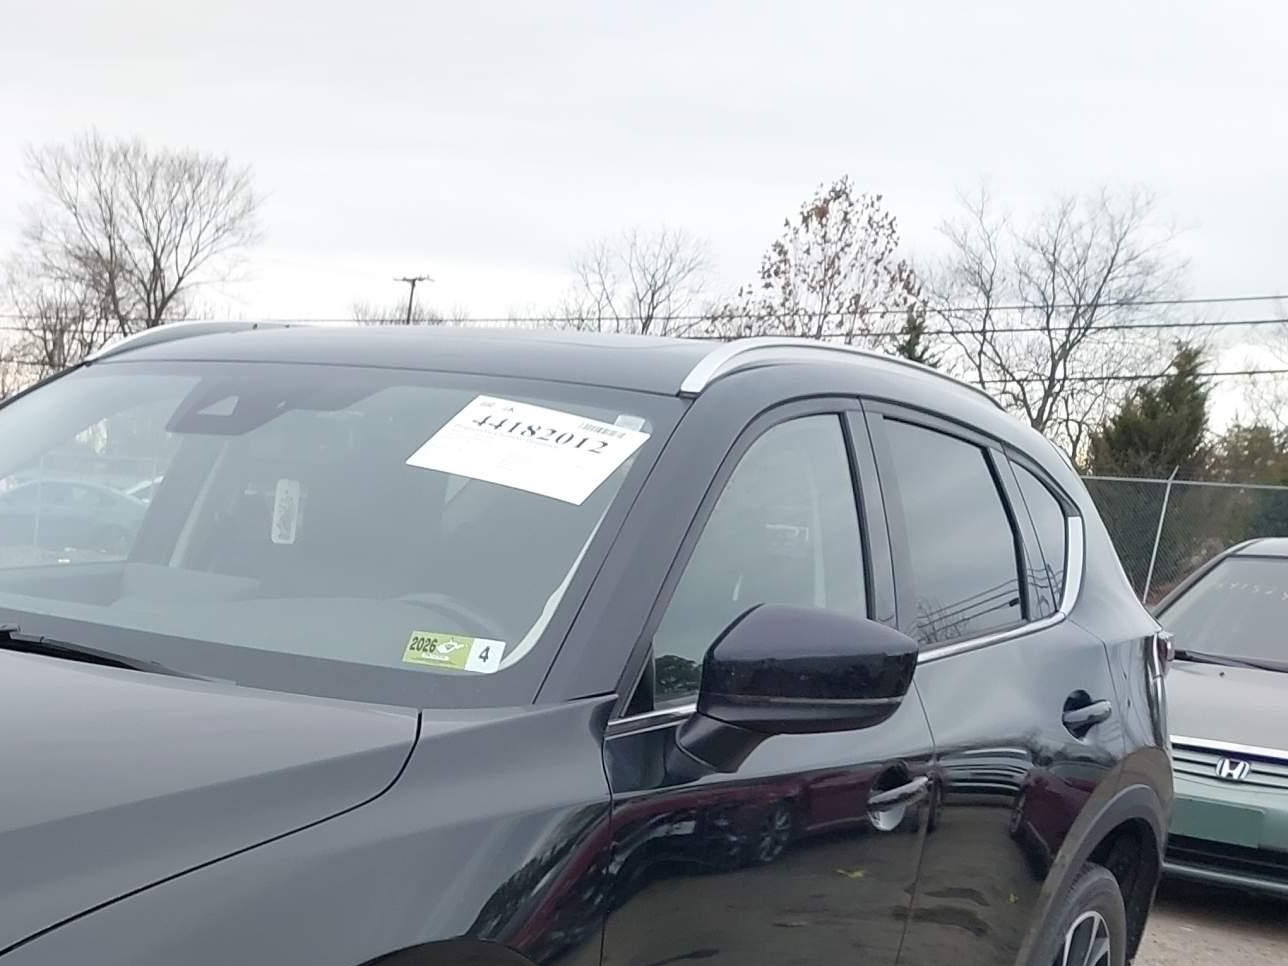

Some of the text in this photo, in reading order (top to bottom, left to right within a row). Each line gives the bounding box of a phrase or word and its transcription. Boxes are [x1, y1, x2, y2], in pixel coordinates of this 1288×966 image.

[472, 414, 609, 455] 44182012
[409, 636, 491, 663] 2026 4
